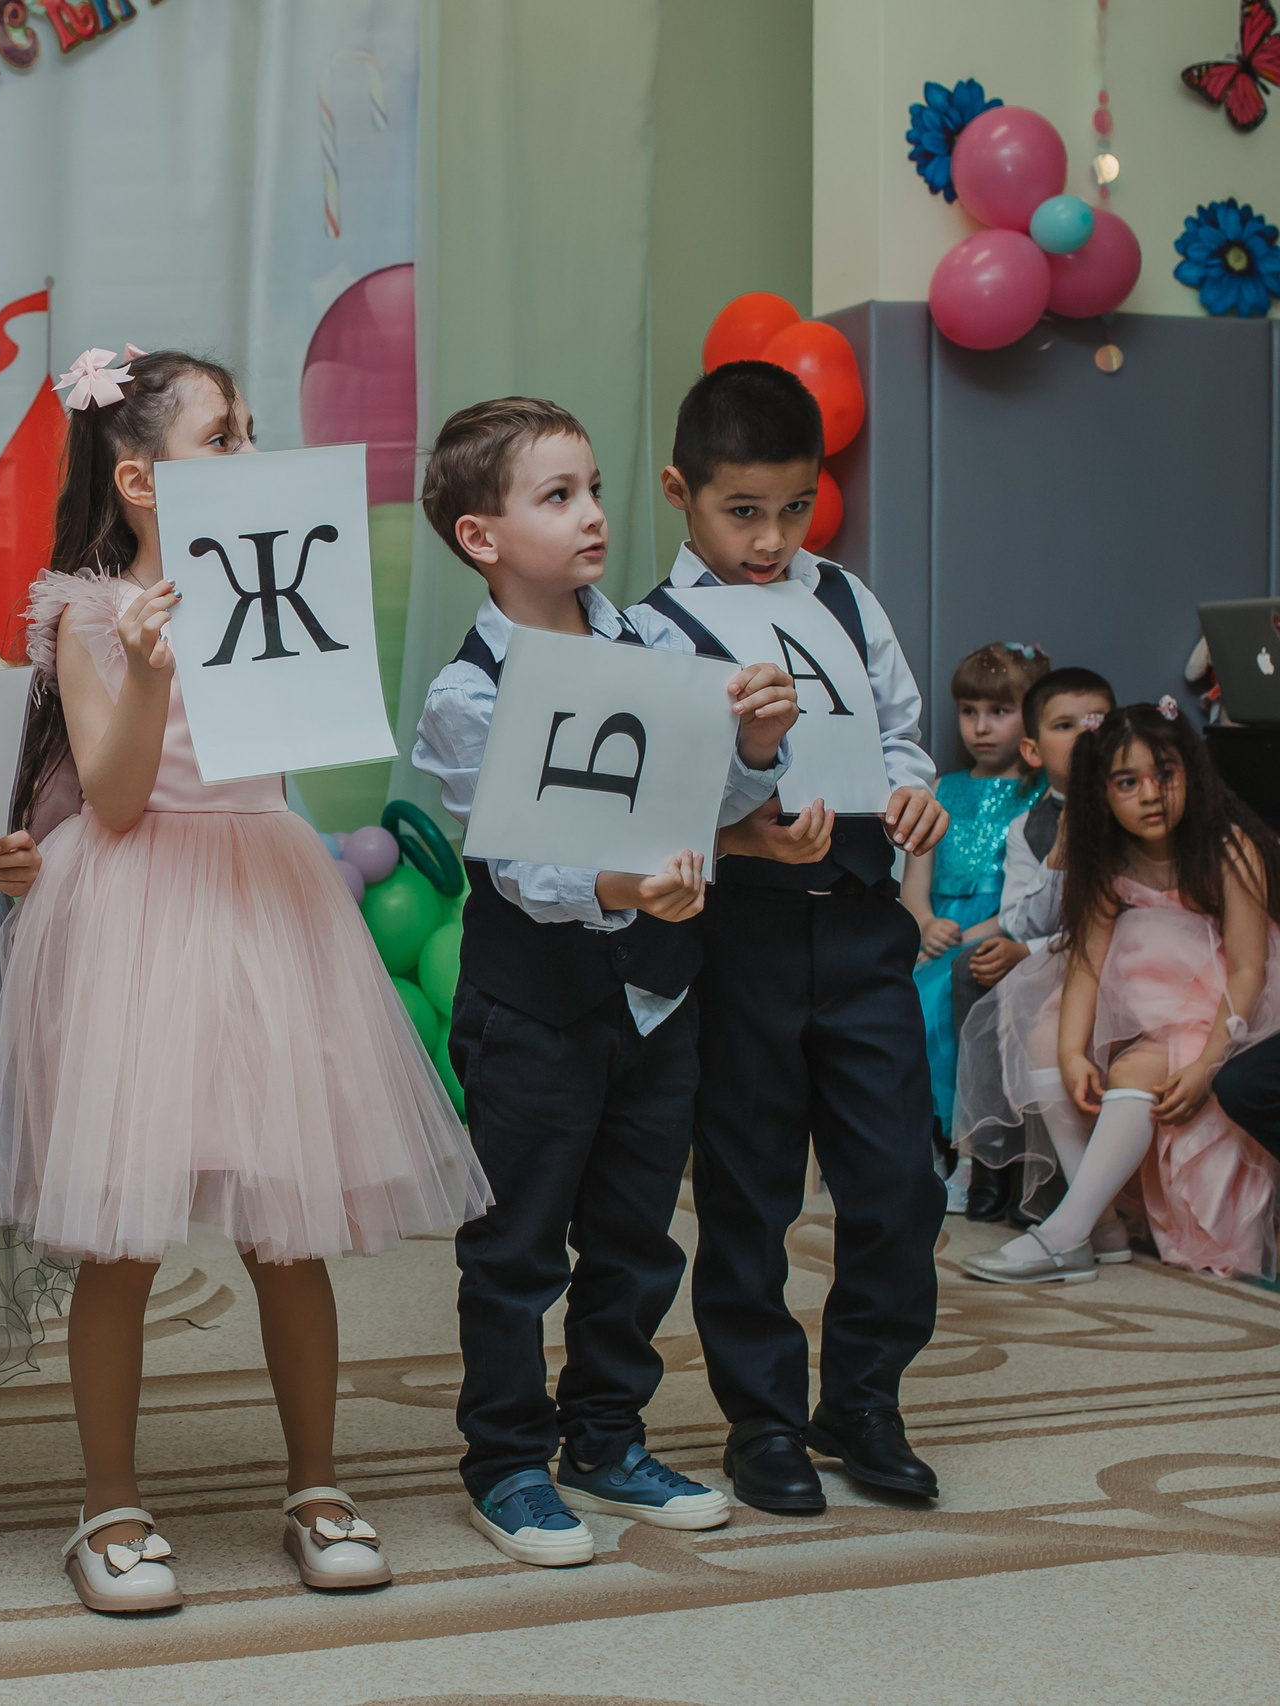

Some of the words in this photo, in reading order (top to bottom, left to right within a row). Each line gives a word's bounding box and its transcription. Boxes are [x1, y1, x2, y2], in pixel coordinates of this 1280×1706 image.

[188, 524, 350, 668] Ж
[771, 622, 855, 716] А
[536, 711, 647, 814] Б
